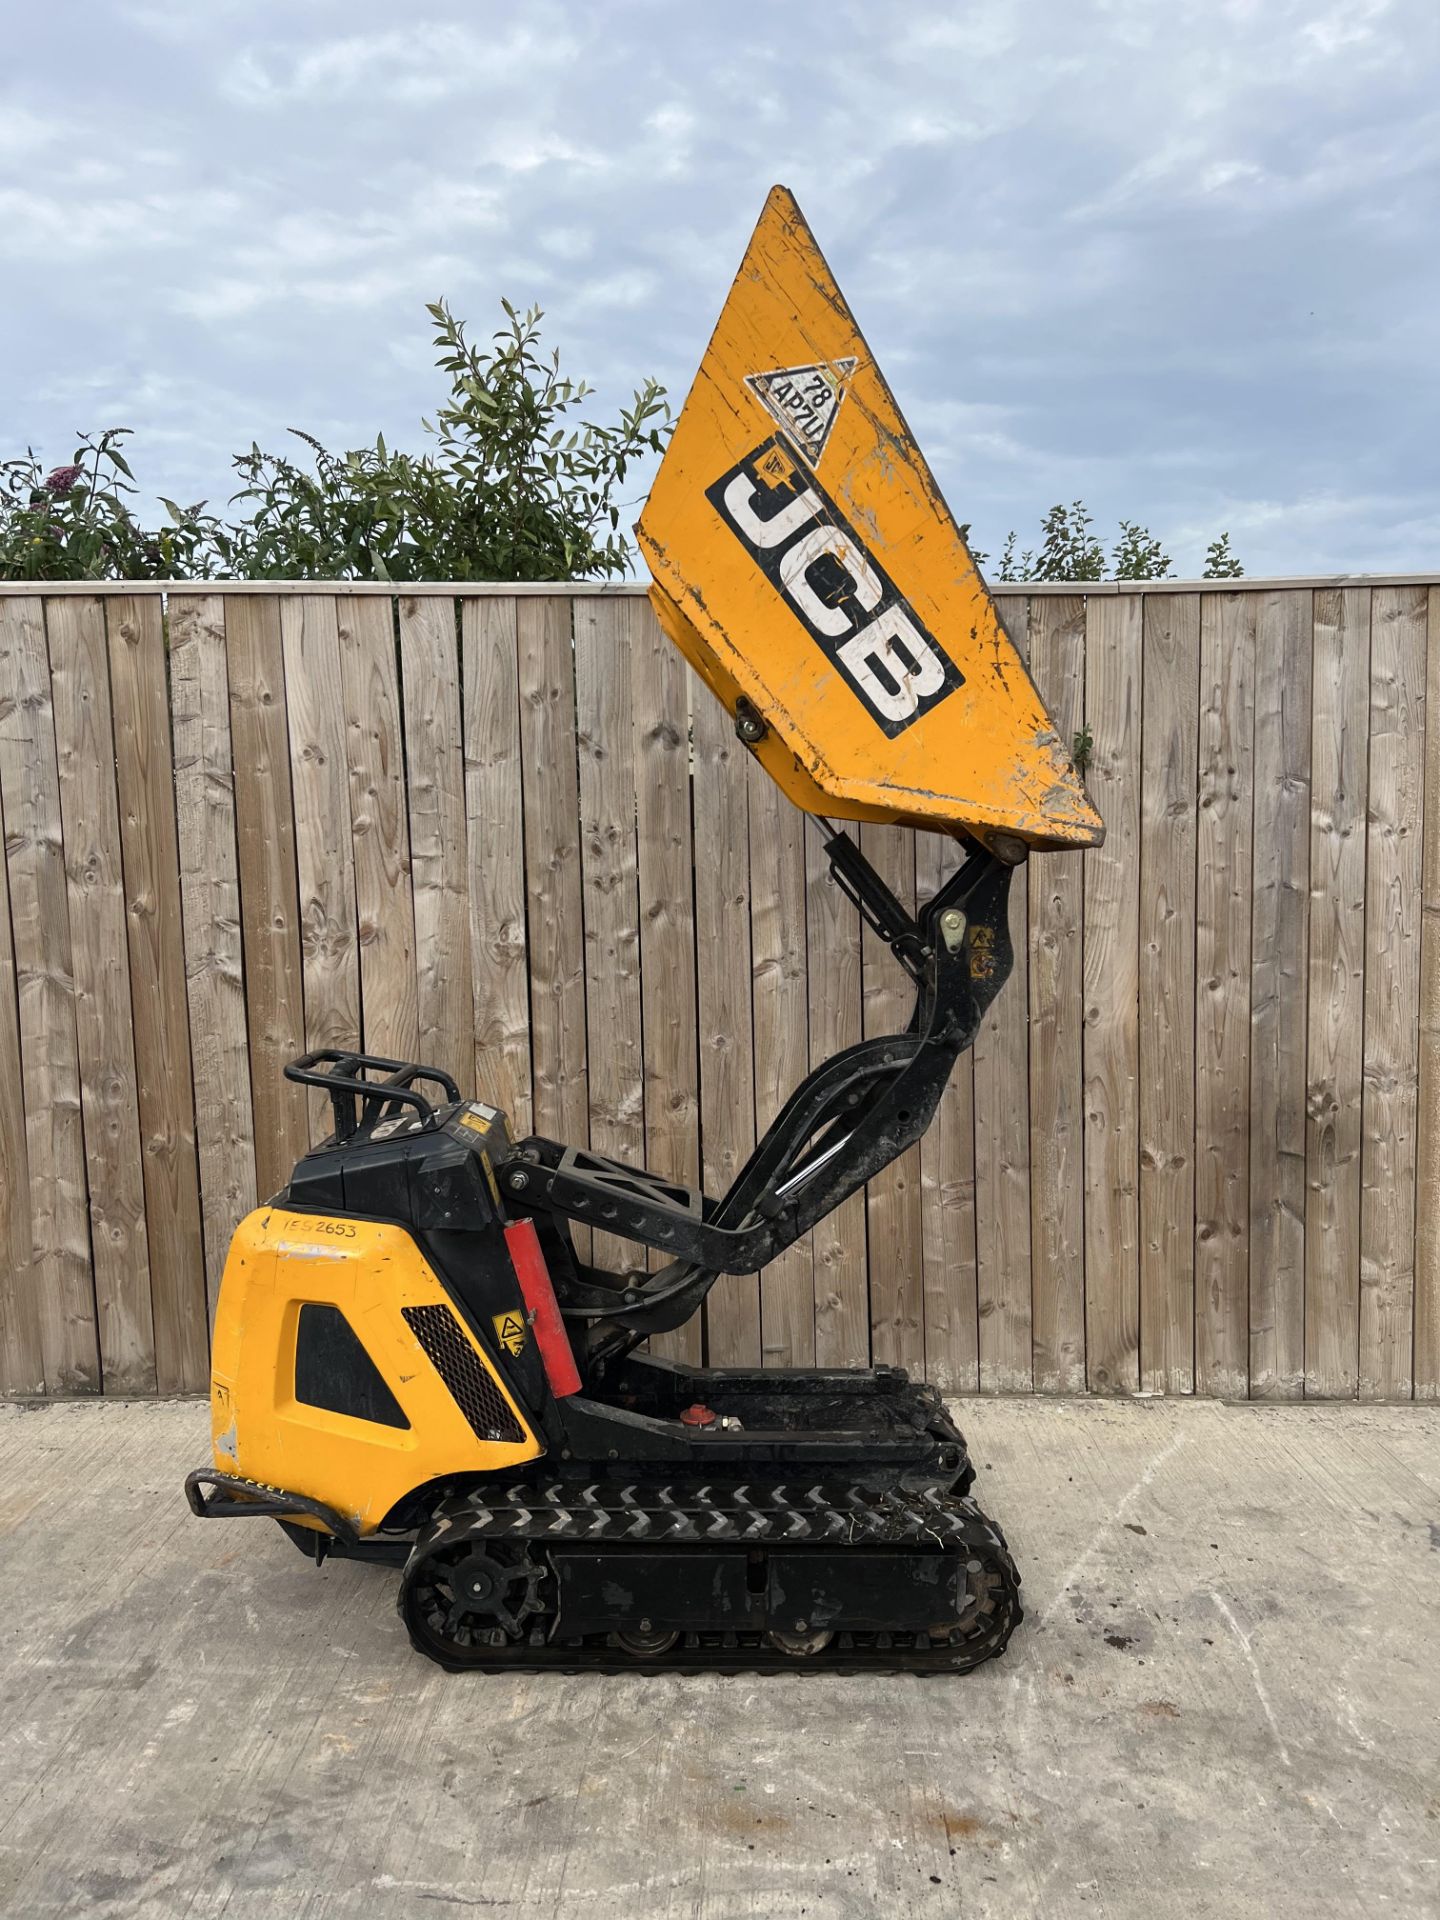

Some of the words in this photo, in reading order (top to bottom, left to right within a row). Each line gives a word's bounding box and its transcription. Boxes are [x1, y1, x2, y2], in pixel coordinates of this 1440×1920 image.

[774, 381, 825, 439] AP7U
[803, 374, 832, 408] 78
[724, 472, 946, 721] JCB
